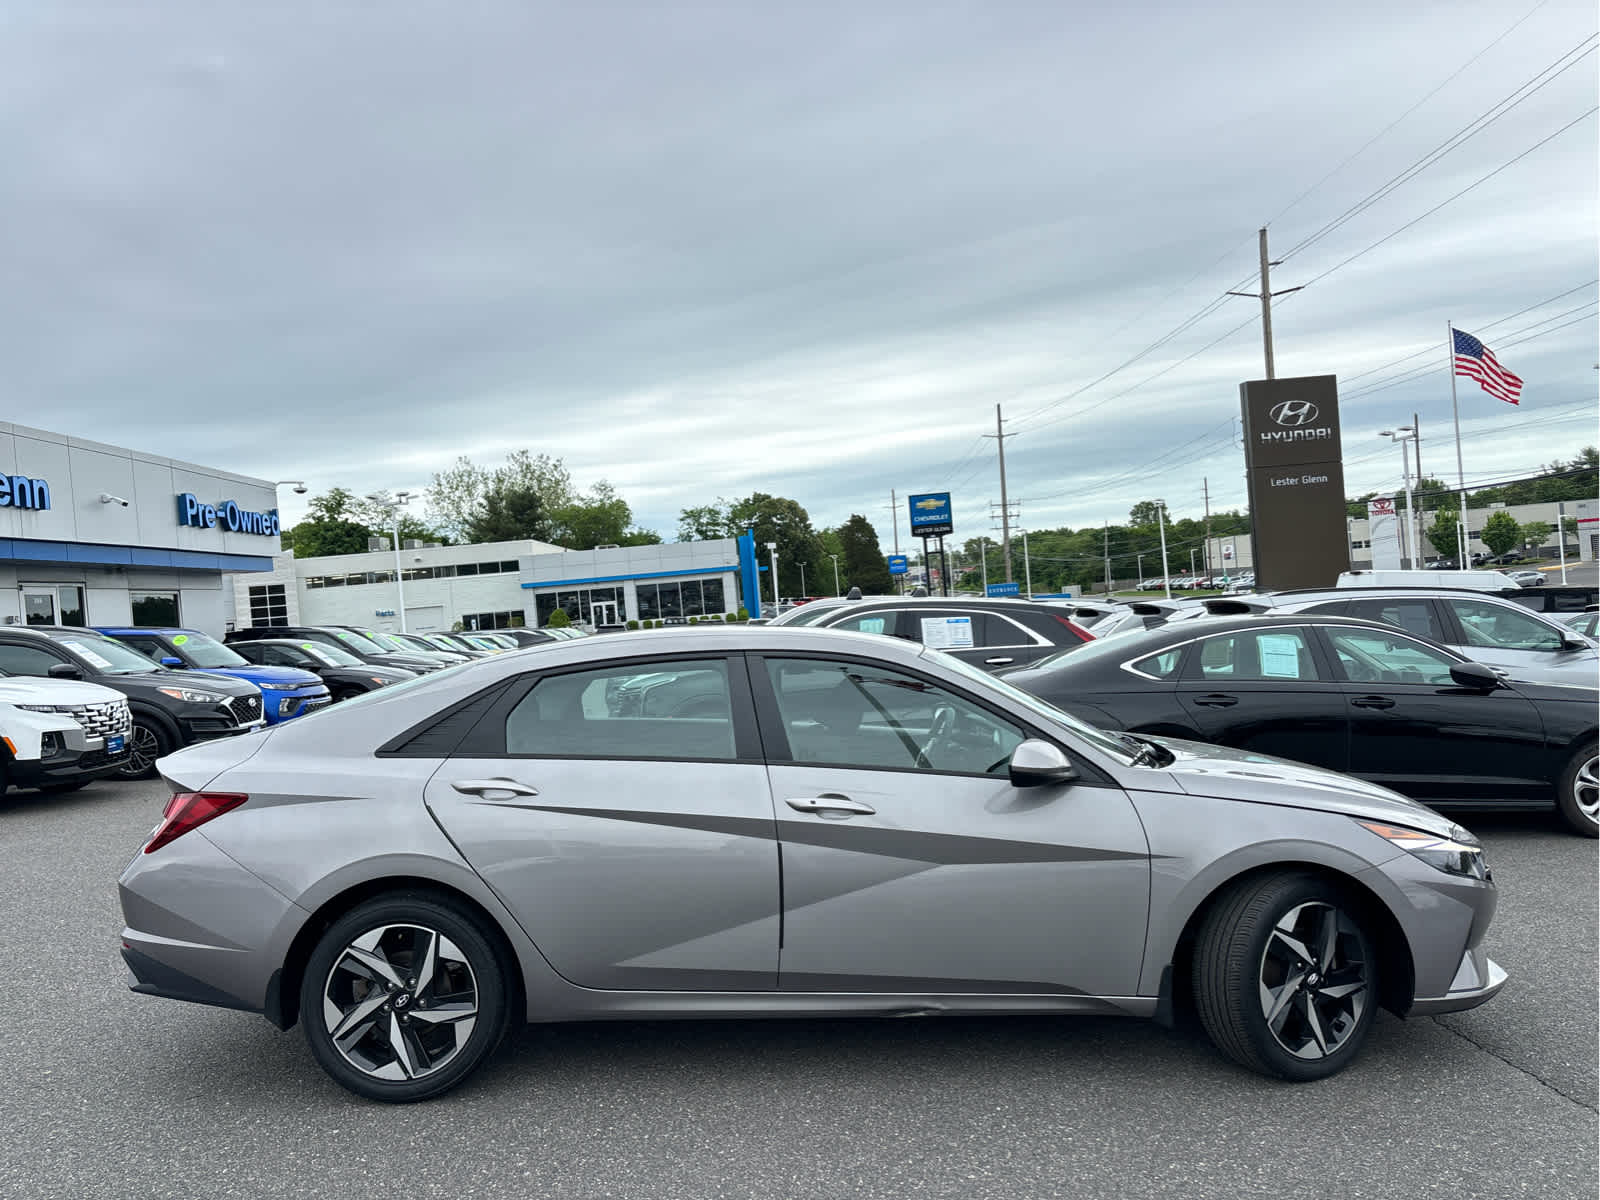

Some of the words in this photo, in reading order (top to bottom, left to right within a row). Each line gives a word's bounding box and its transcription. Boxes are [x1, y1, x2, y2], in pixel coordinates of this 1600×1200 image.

[1260, 427, 1331, 444] HYUNDAI
[1270, 477, 1299, 487] Lester
[1302, 475, 1328, 484] Glenn
[177, 493, 280, 536] Pre-Owned
[913, 514, 949, 522] CHEVROLET
